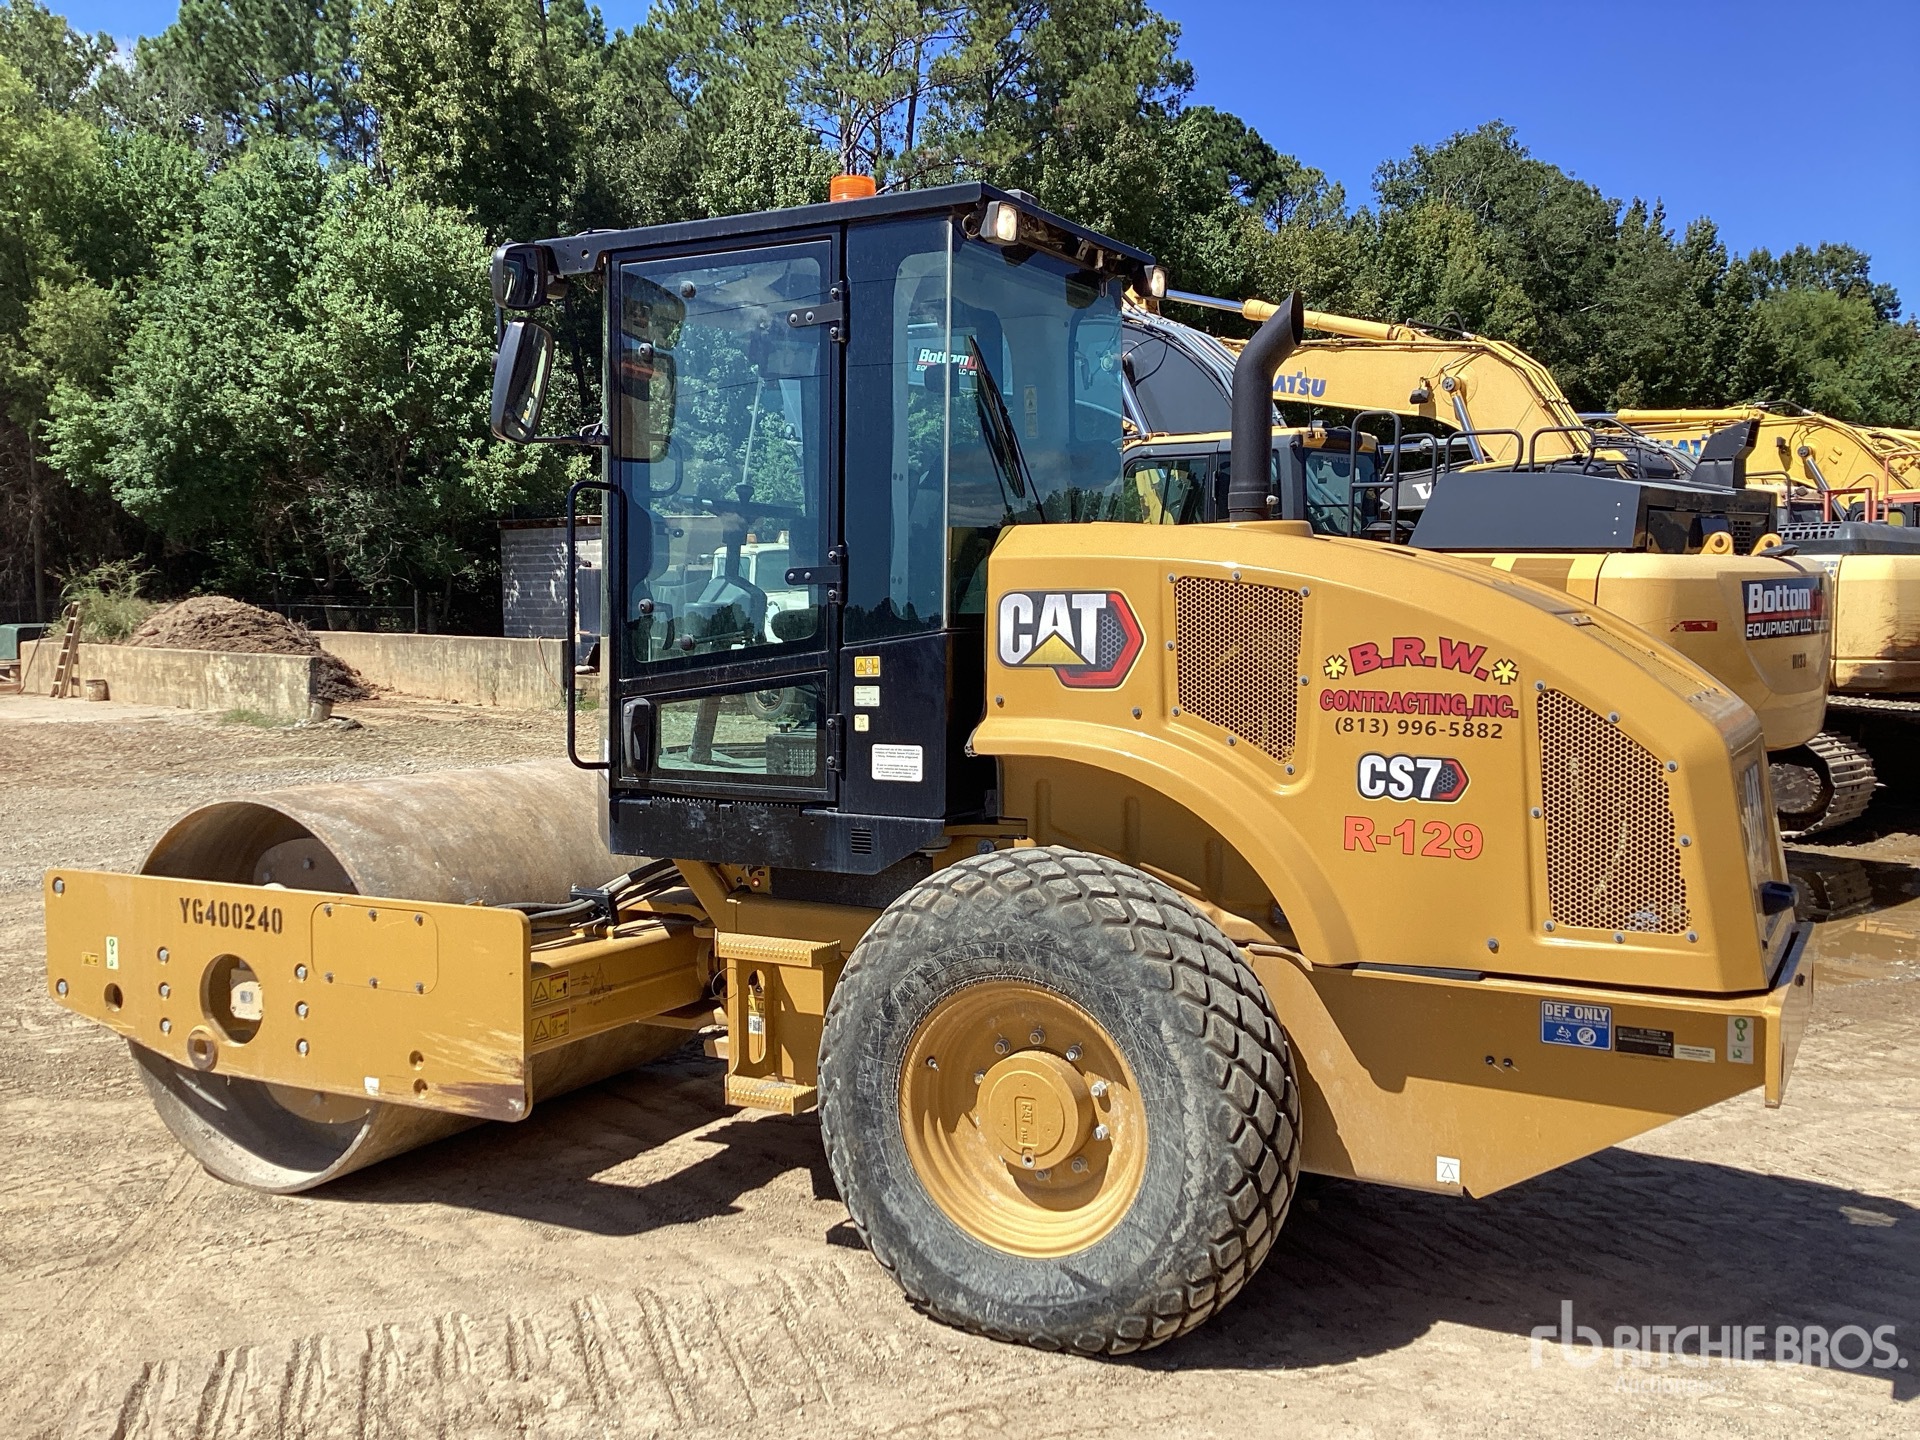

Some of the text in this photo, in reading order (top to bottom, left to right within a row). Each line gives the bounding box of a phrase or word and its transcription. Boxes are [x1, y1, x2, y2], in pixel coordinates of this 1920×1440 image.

[1272, 371, 1327, 397] ATSU
[1000, 593, 1107, 665] CAT
[1746, 620, 1800, 638] EQUIPMENT
[1800, 618, 1812, 632] LLC
[1348, 636, 1490, 682] B.R.W.
[1335, 716, 1503, 739] (813) 996-5882
[1359, 754, 1442, 799] CS7
[1343, 815, 1484, 861] R-129
[179, 897, 283, 935] YG400240
[1544, 1003, 1570, 1018] DEF
[1574, 1006, 1608, 1022] ONLY
